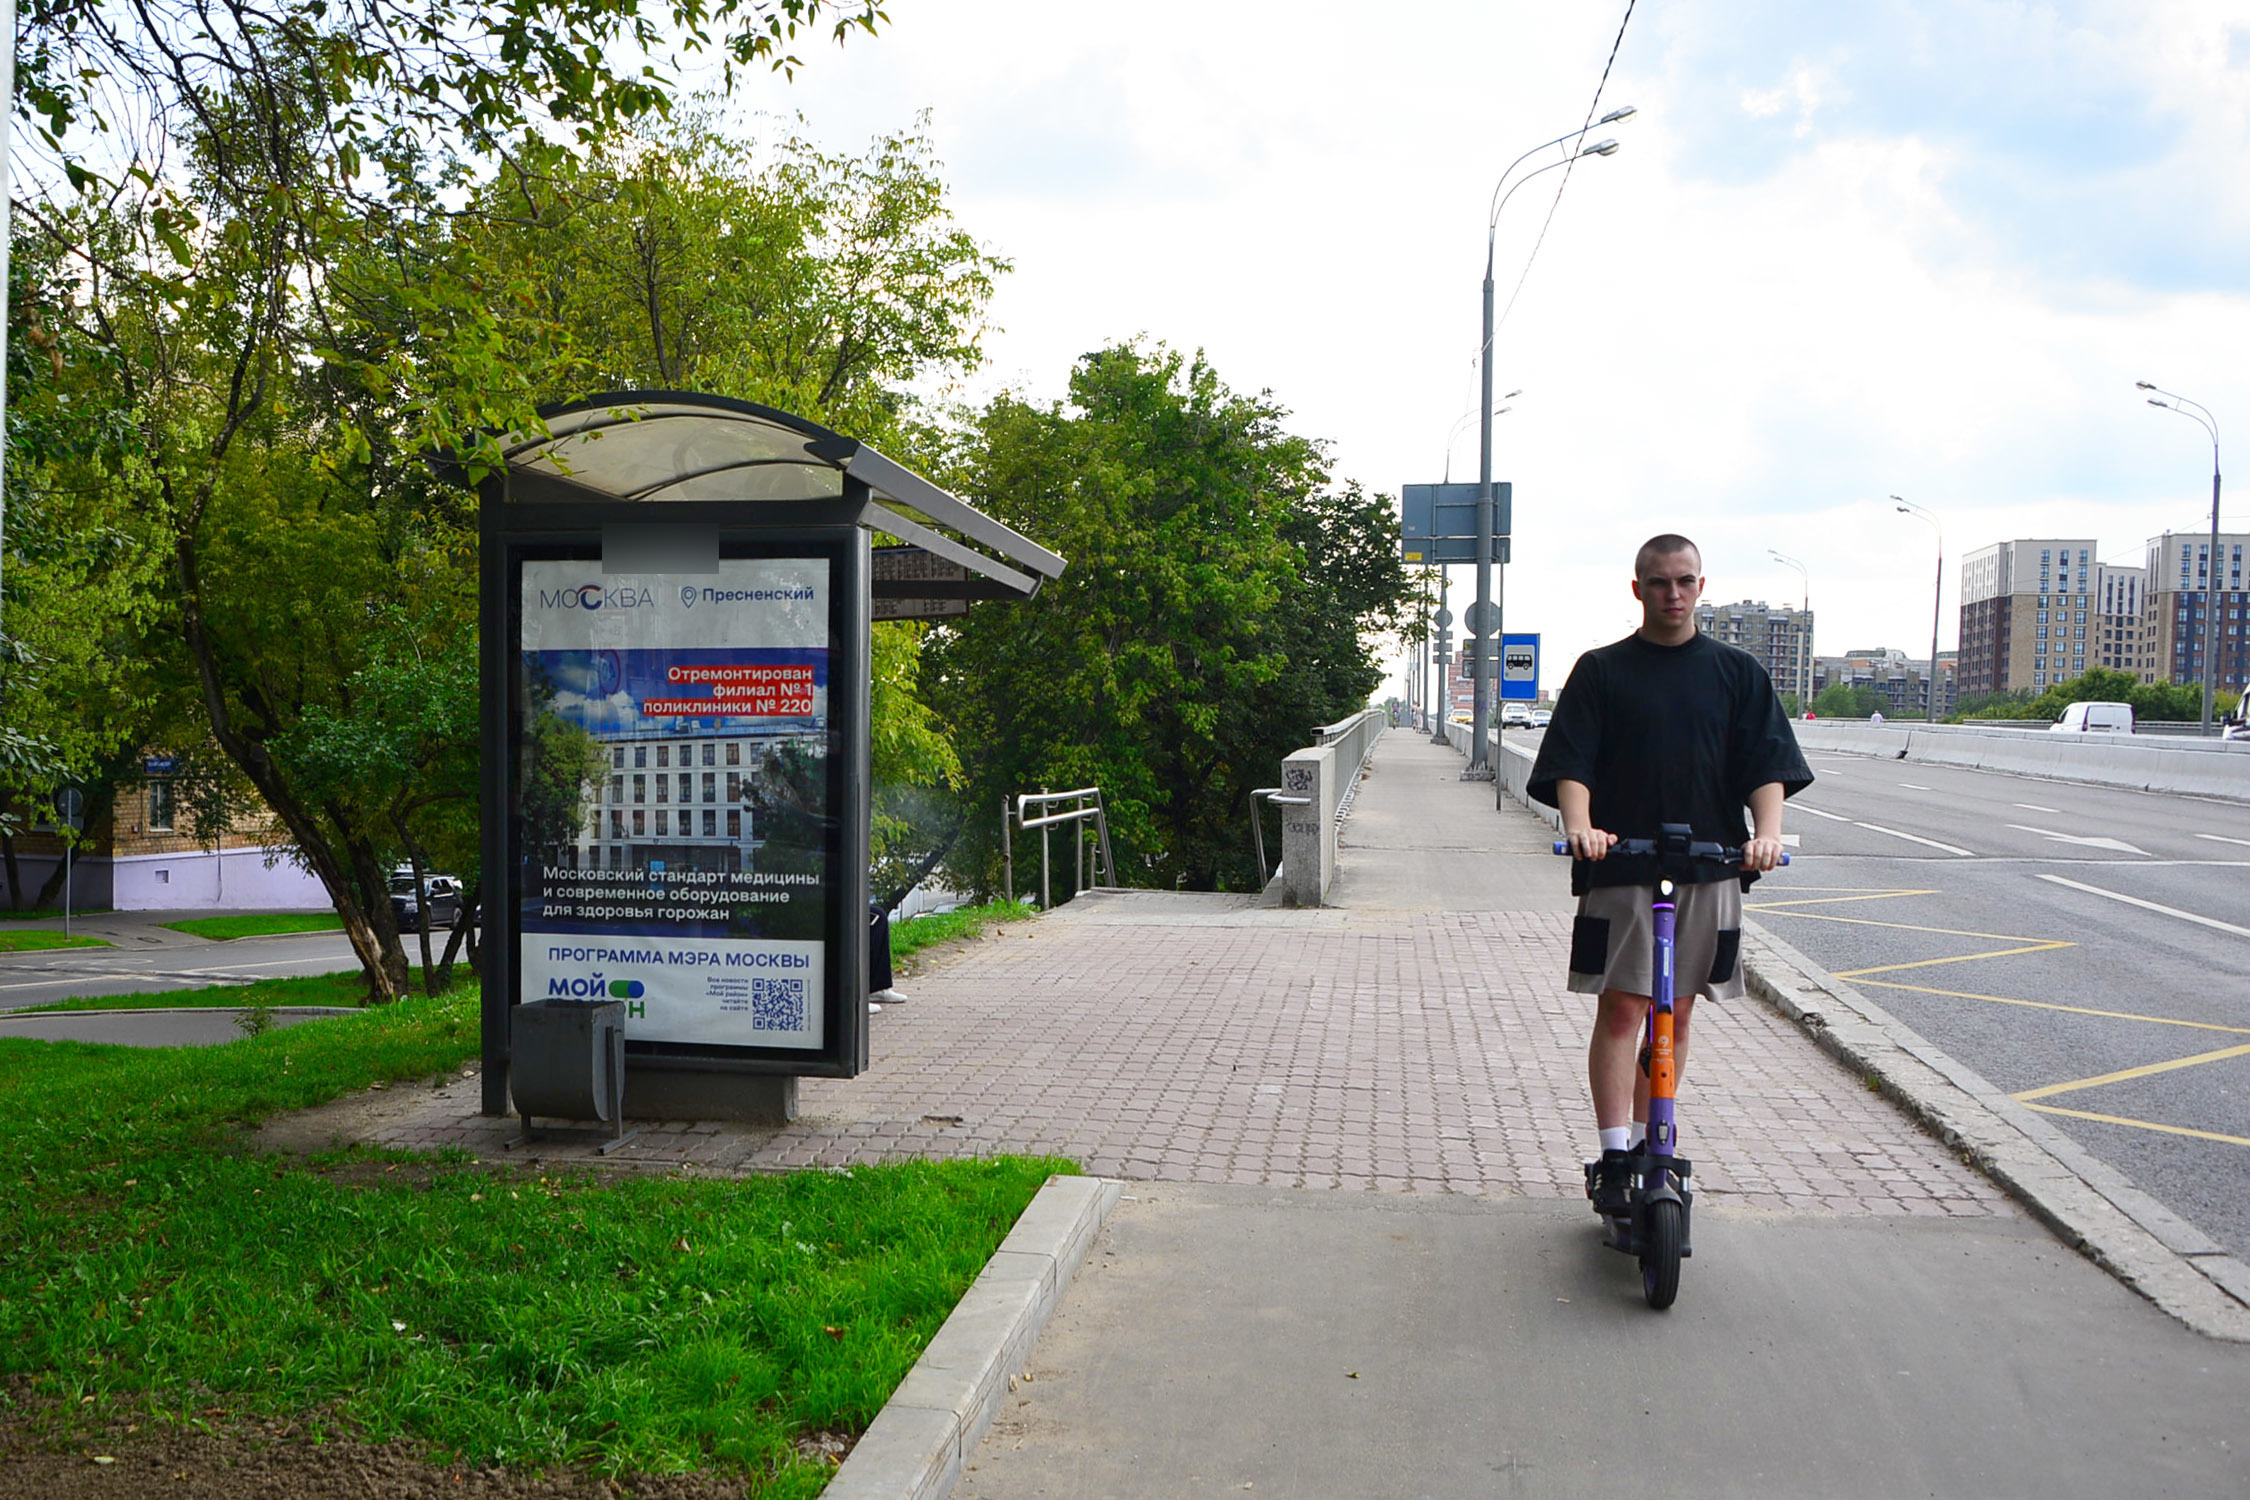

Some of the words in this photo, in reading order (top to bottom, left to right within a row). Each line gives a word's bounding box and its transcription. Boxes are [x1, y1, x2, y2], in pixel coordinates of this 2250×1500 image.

[540, 584, 655, 611] МОСКВА
[702, 586, 815, 604] Пресненский
[668, 667, 813, 683] Отремонтирован
[713, 684, 776, 699] филиал
[805, 684, 813, 696] 1
[643, 702, 751, 713] поликлиники
[780, 700, 813, 713] 220
[543, 866, 644, 881] Московский
[648, 871, 726, 886] стандарт
[730, 873, 820, 886] медицины
[543, 887, 553, 897] и
[556, 887, 665, 902] современное
[669, 887, 790, 904] оборудование
[543, 905, 573, 917] для
[576, 906, 654, 920] здоровья
[658, 908, 730, 922] горожан
[549, 948, 664, 964] ПРОГРАММА
[668, 951, 721, 966] МЭРА
[725, 952, 810, 968] МОСКВЫ
[548, 972, 606, 997] МОЙ
